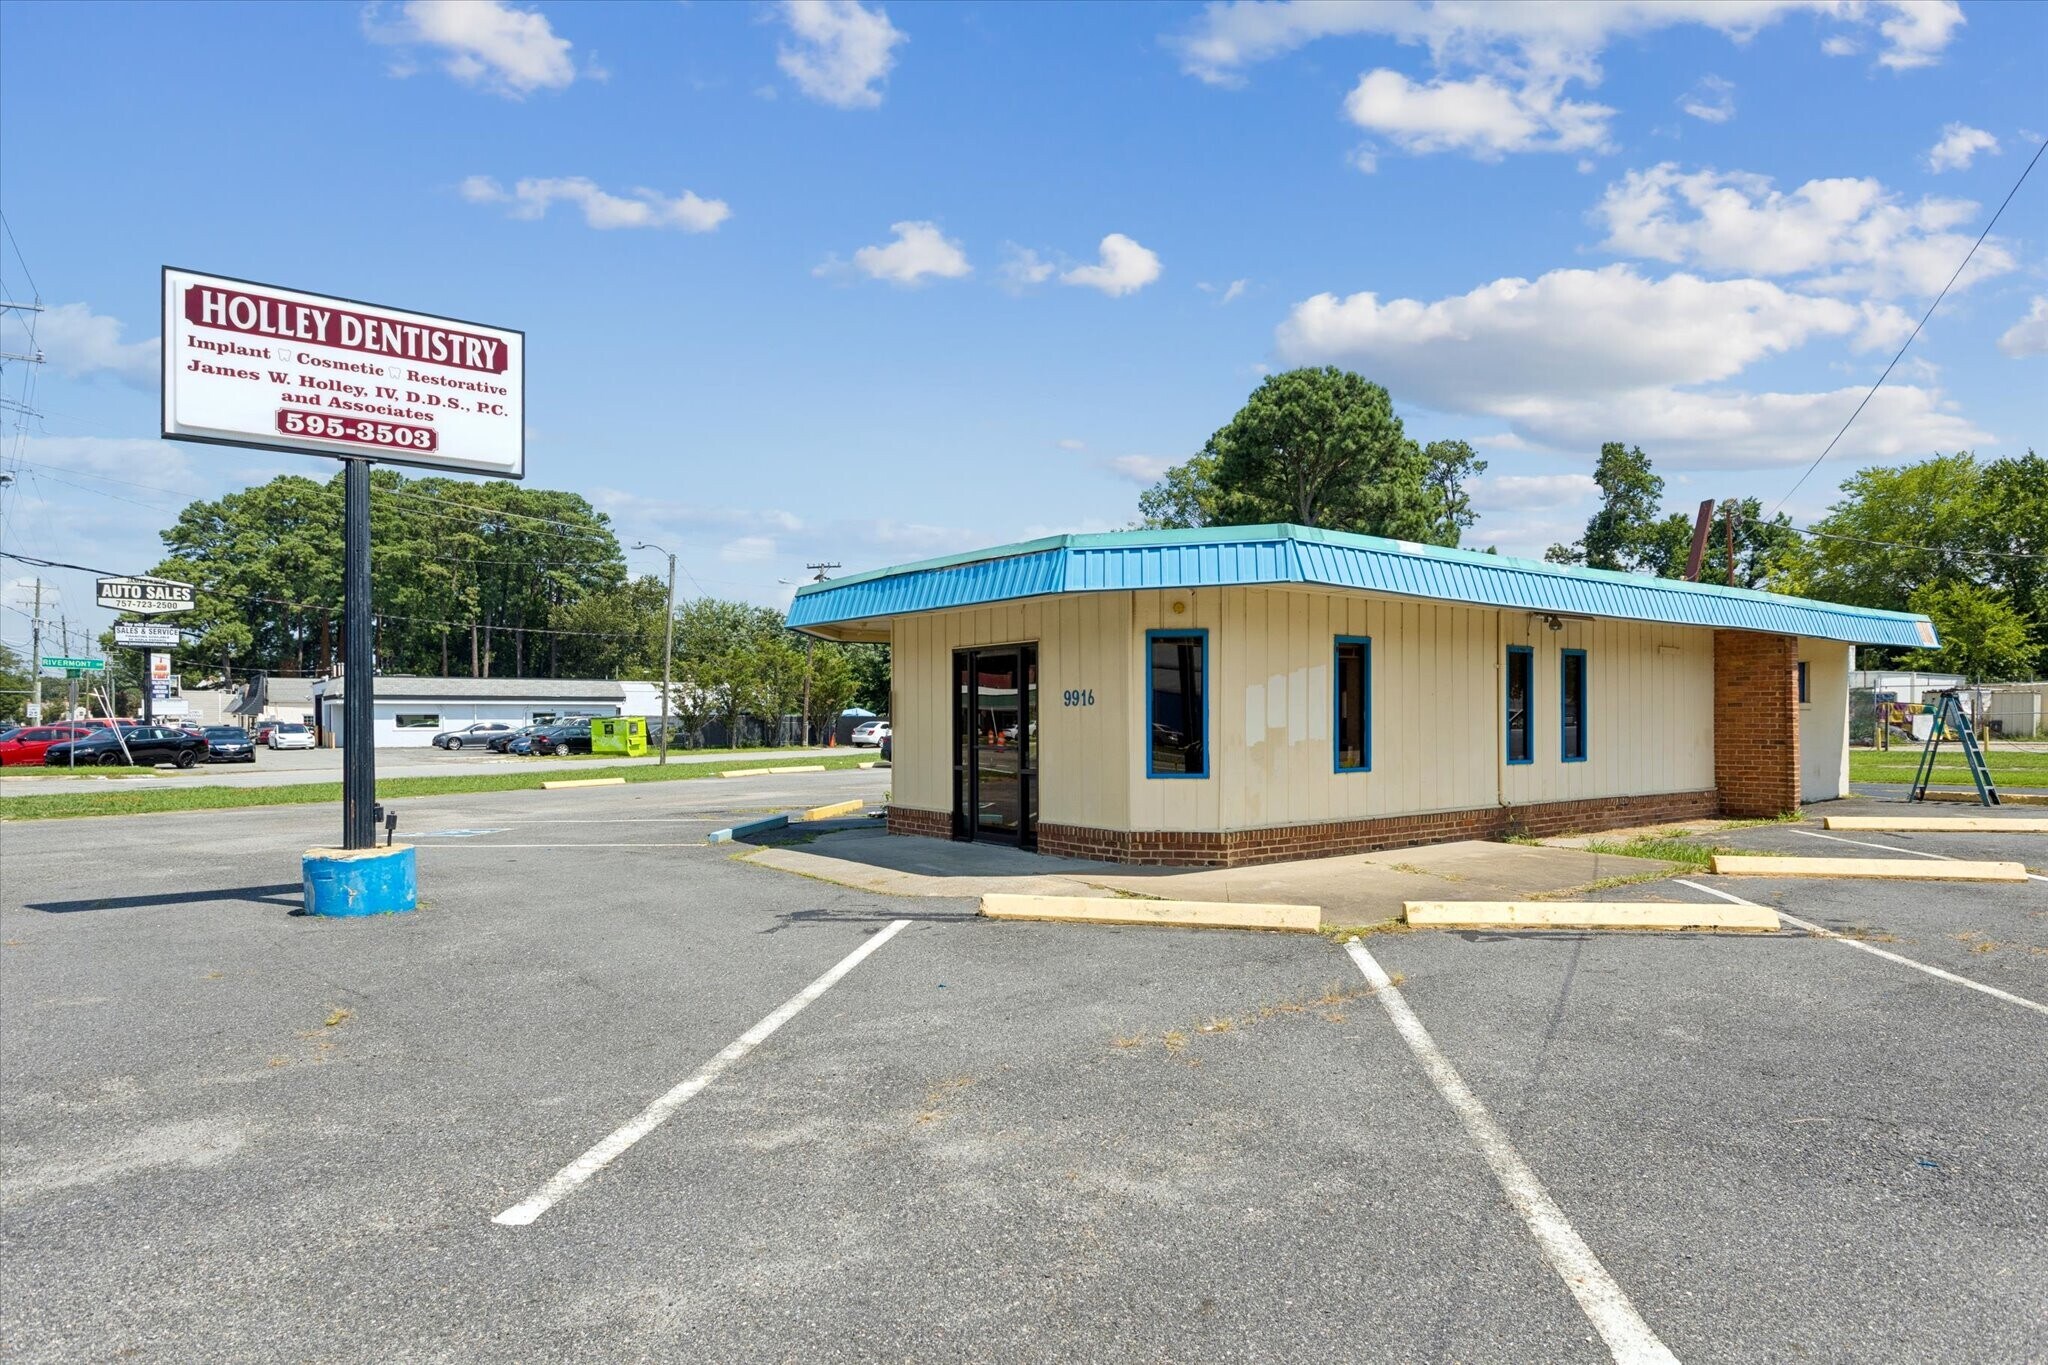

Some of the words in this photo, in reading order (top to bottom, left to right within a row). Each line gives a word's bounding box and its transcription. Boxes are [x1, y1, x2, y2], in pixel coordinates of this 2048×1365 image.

[202, 290, 331, 342] HOLLEY
[340, 314, 498, 370] DENTISTRY
[187, 334, 271, 359] Implant
[296, 352, 384, 376] Cosmetic
[407, 369, 507, 396] Restorative
[187, 359, 260, 381] James
[267, 370, 291, 385] W.
[299, 374, 368, 398] Holley,
[375, 386, 399, 402] IV,
[406, 390, 471, 412] D.D.S.,
[476, 401, 508, 417] P.C.
[281, 391, 321, 406] and
[327, 396, 434, 422] Associates
[285, 412, 431, 449] 595-3503
[101, 584, 142, 599] AUTO
[146, 586, 191, 601] SALES
[115, 599, 178, 609] 757-723-2500
[116, 627, 139, 635] SALES
[148, 628, 179, 636] SERVICE
[42, 658, 91, 667] RIVERMONT
[1063, 688, 1095, 707] 9916
